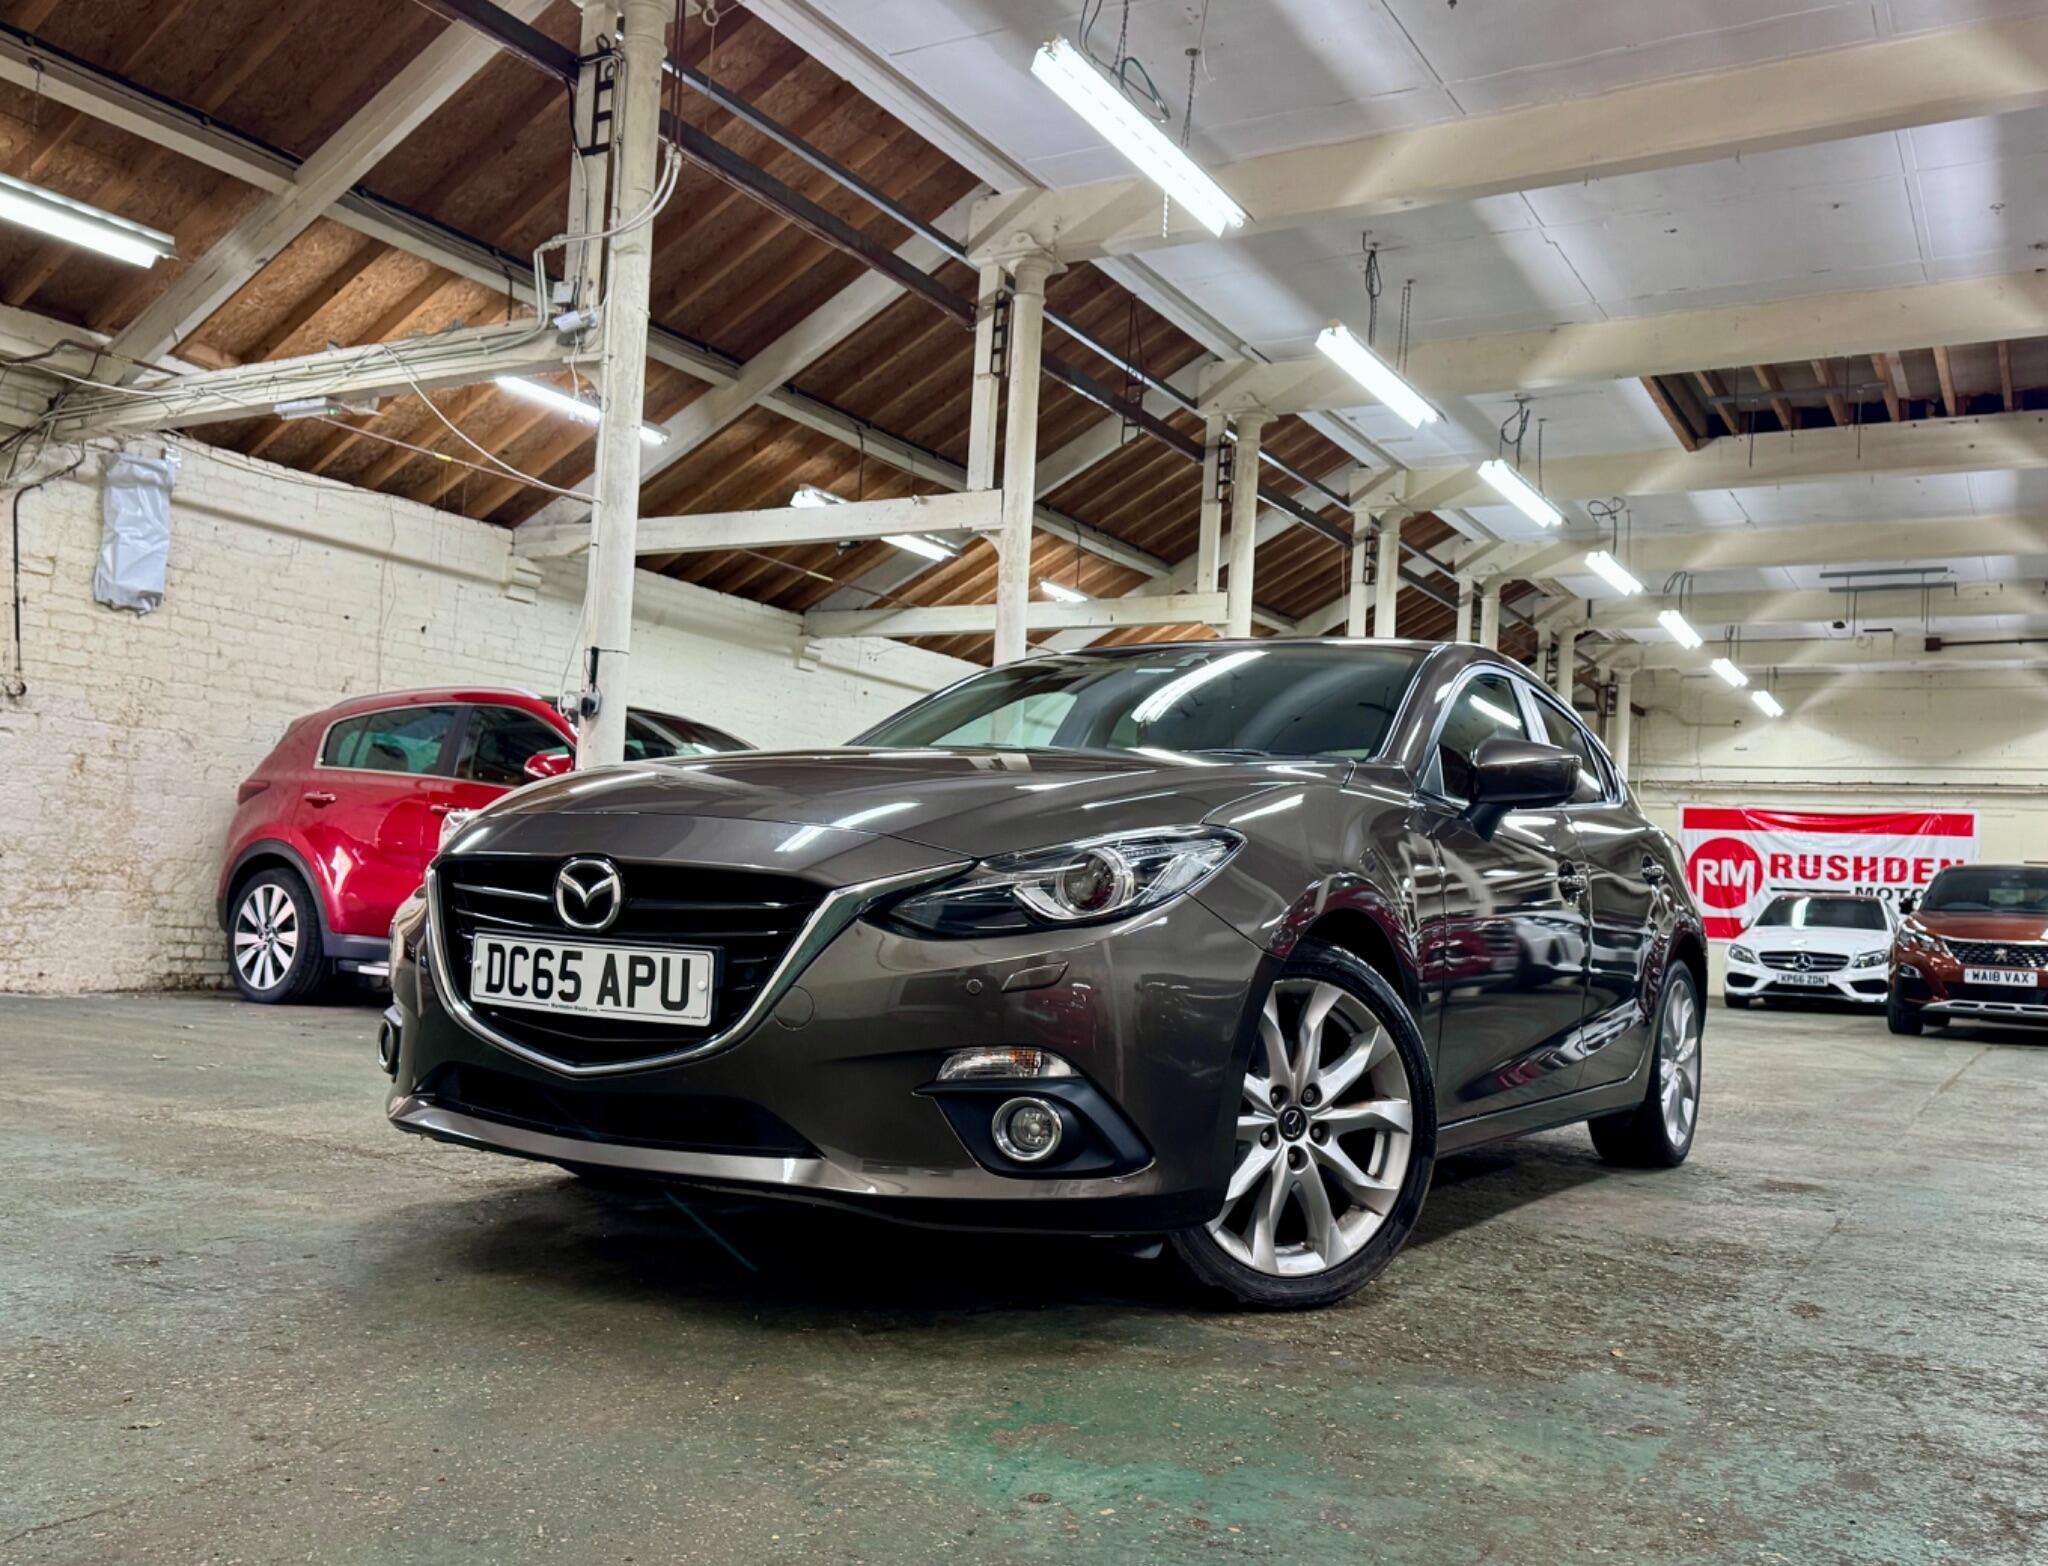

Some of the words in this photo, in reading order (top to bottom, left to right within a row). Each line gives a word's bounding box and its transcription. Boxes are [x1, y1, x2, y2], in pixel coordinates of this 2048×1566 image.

[1697, 858, 1755, 898] RM
[1769, 853, 1965, 884] RUSHDE
[485, 943, 583, 1002] DC65
[596, 953, 691, 1012] APU
[2004, 971, 2029, 984] VAX
